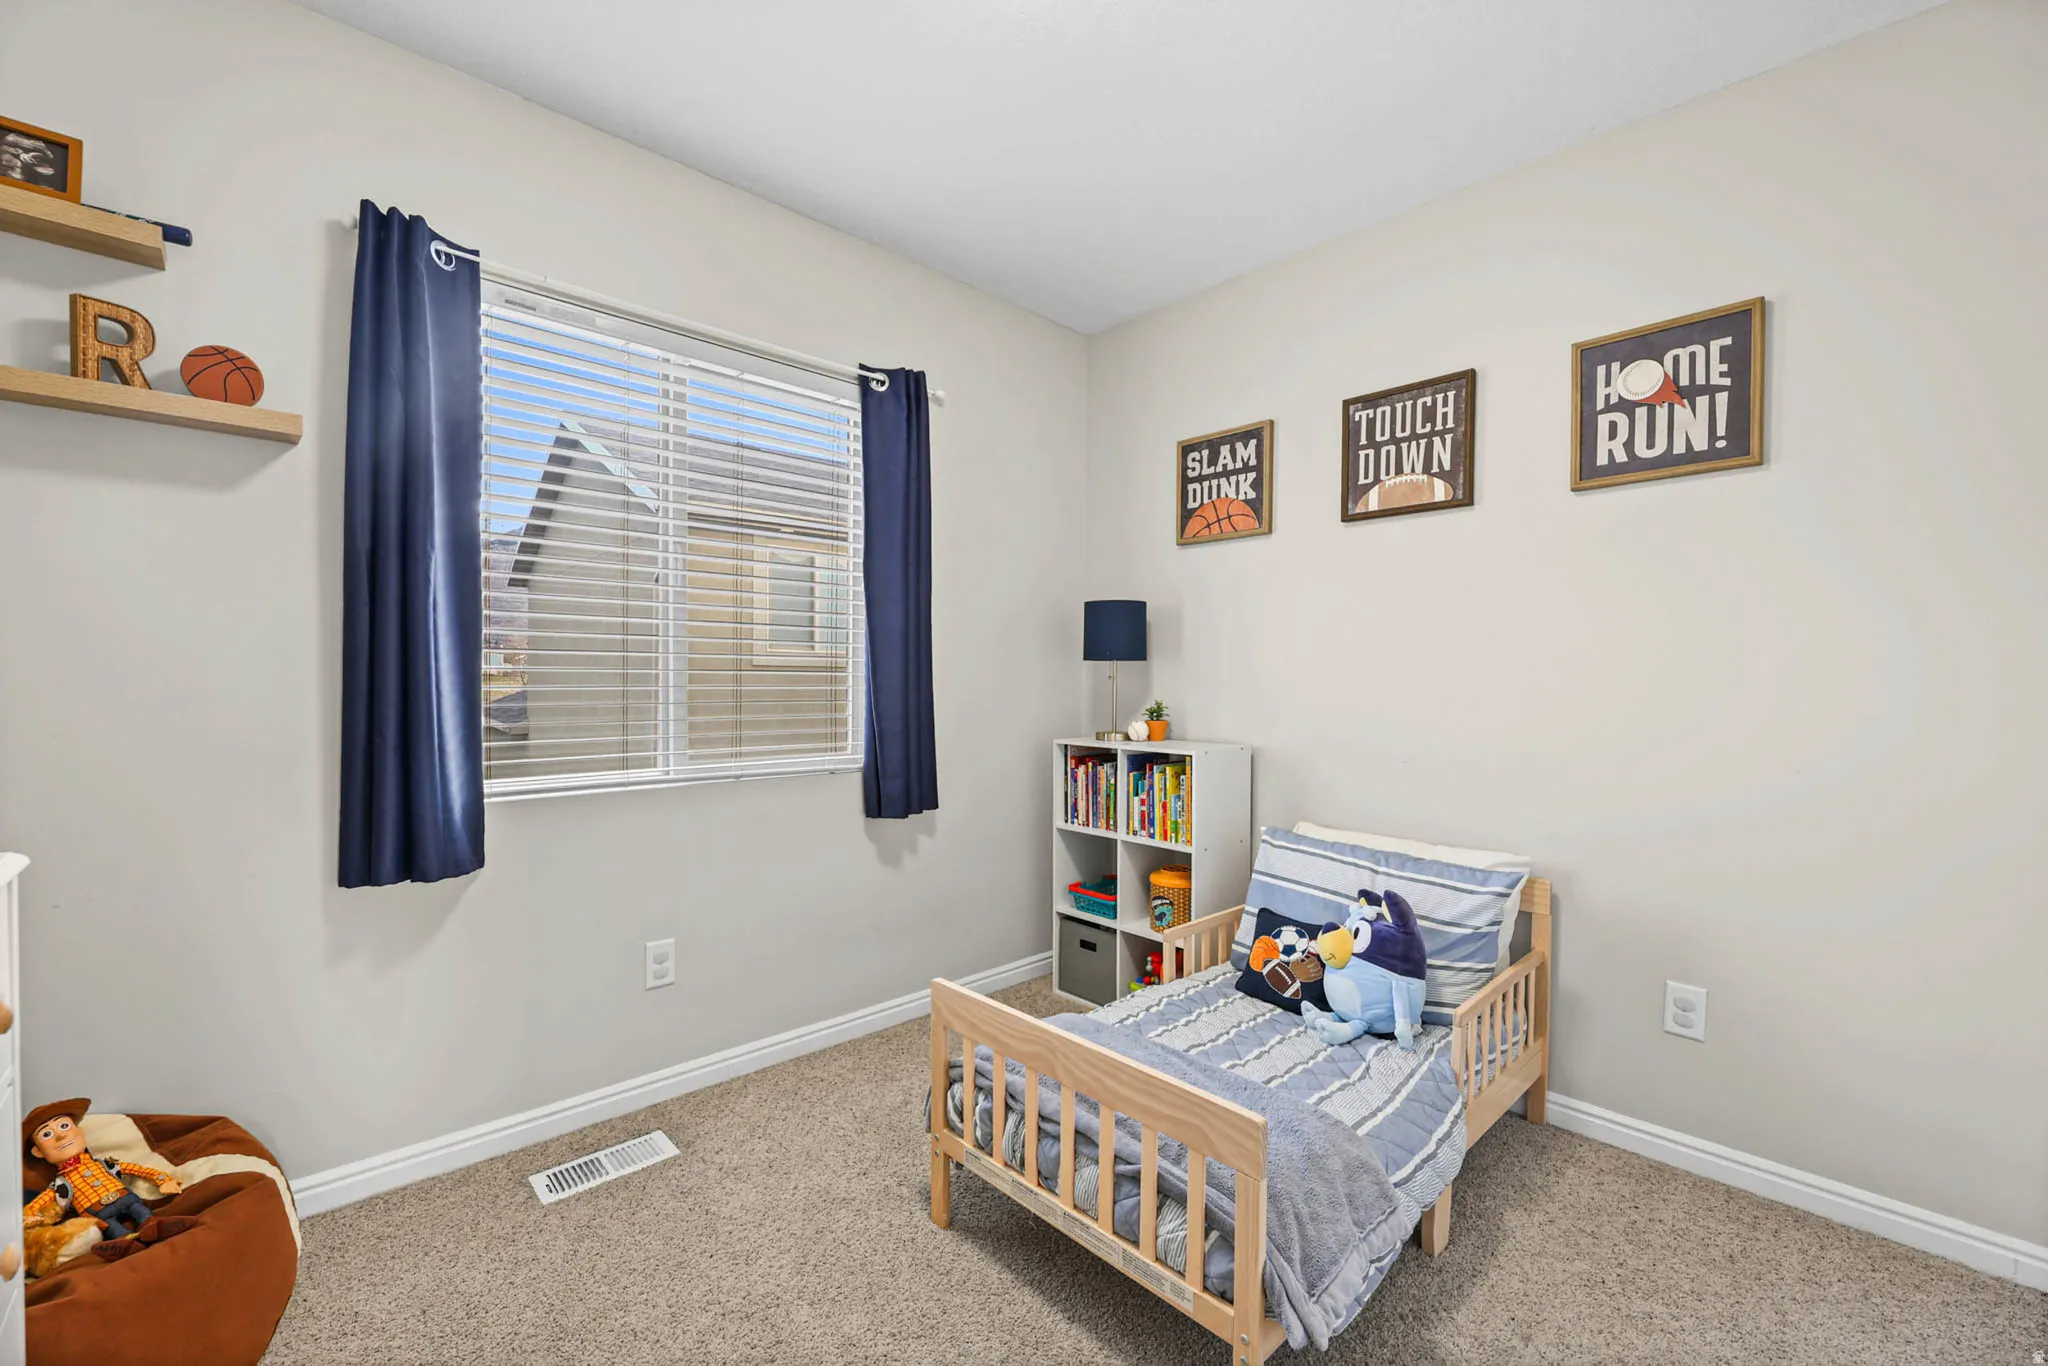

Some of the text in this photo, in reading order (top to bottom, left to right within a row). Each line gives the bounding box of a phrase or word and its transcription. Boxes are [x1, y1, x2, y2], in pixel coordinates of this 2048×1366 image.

[69, 293, 156, 390] R
[1354, 390, 1456, 445] TOUCH
[1596, 391, 1729, 466] RUN!
[1186, 438, 1257, 478] SLAM
[1357, 433, 1454, 485] DOWN
[1186, 471, 1257, 510] DUNK
